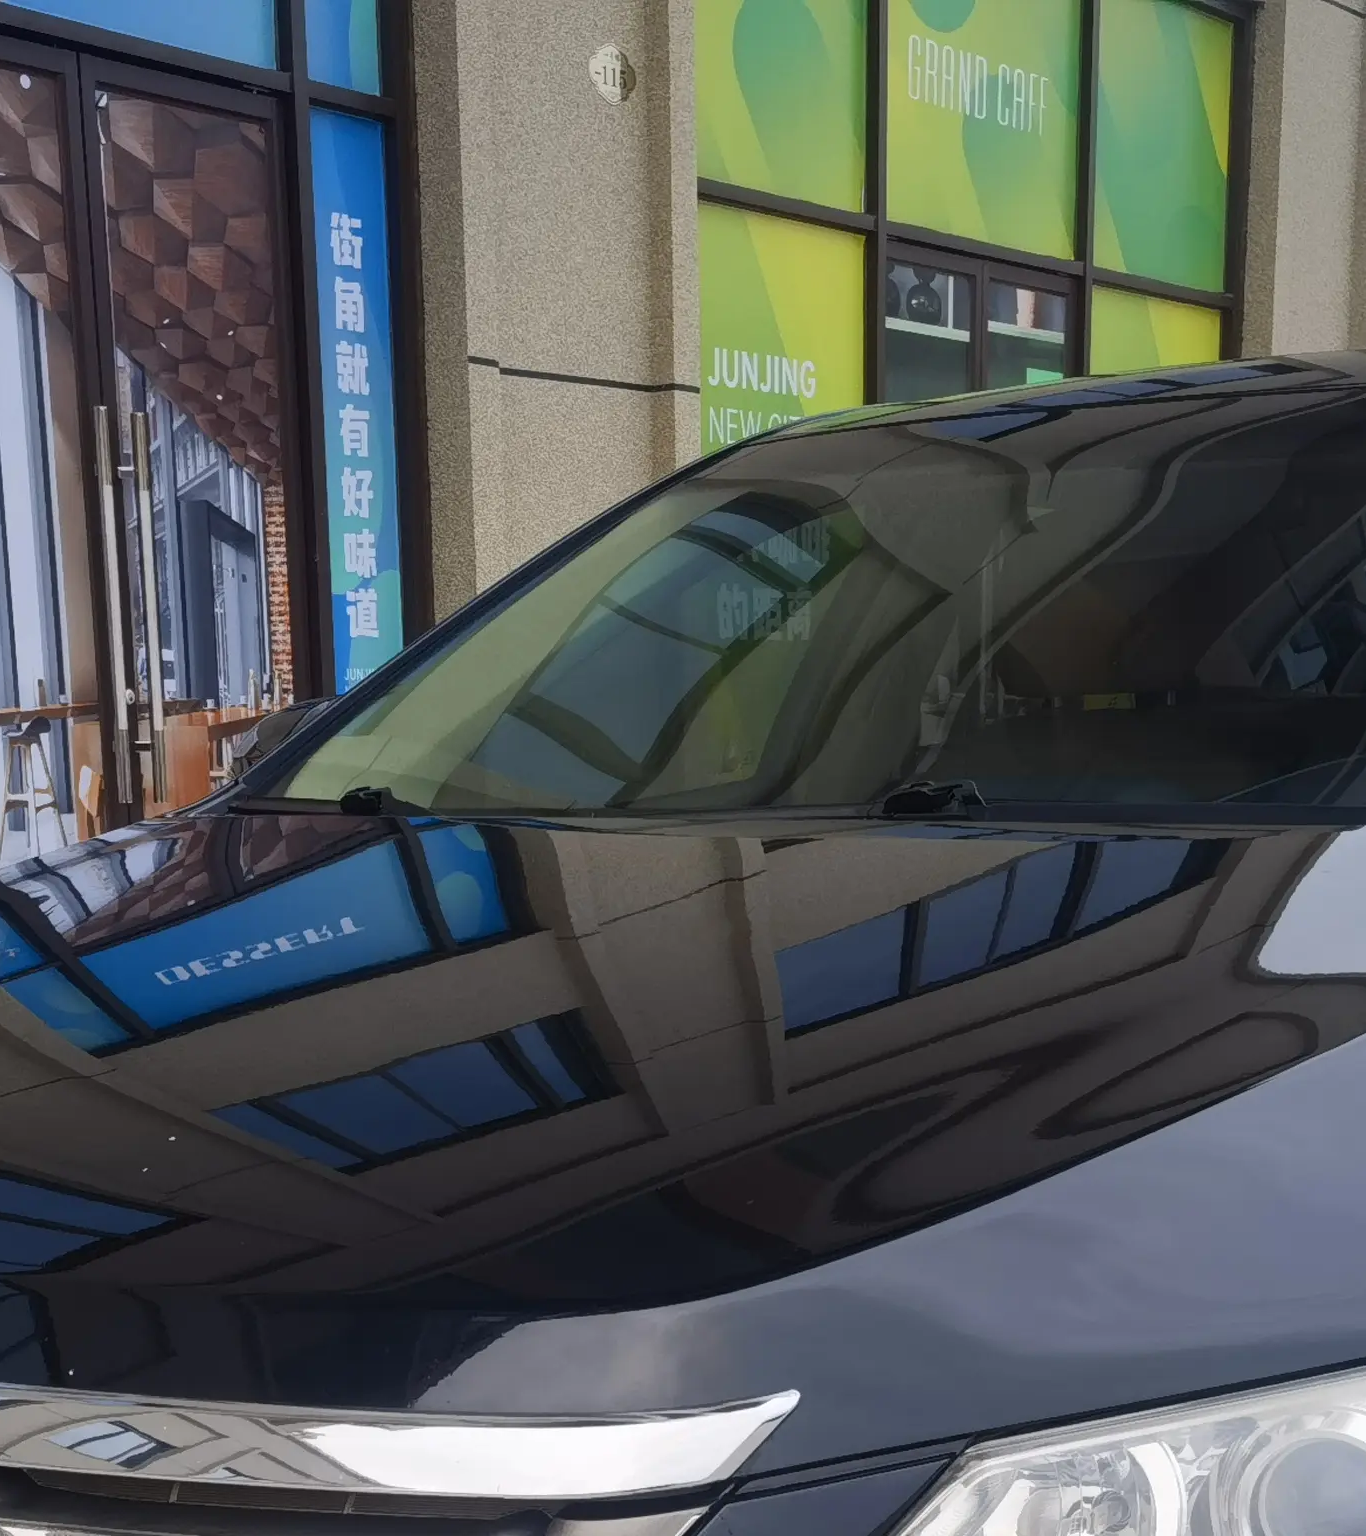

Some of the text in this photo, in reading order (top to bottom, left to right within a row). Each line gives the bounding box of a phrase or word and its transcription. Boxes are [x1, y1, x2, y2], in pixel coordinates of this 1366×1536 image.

[908, 34, 1049, 136] GRAND CAFF
[708, 347, 816, 399] JUNJING
[329, 212, 381, 638] 街角就有好味道
[709, 406, 762, 445] NEW
